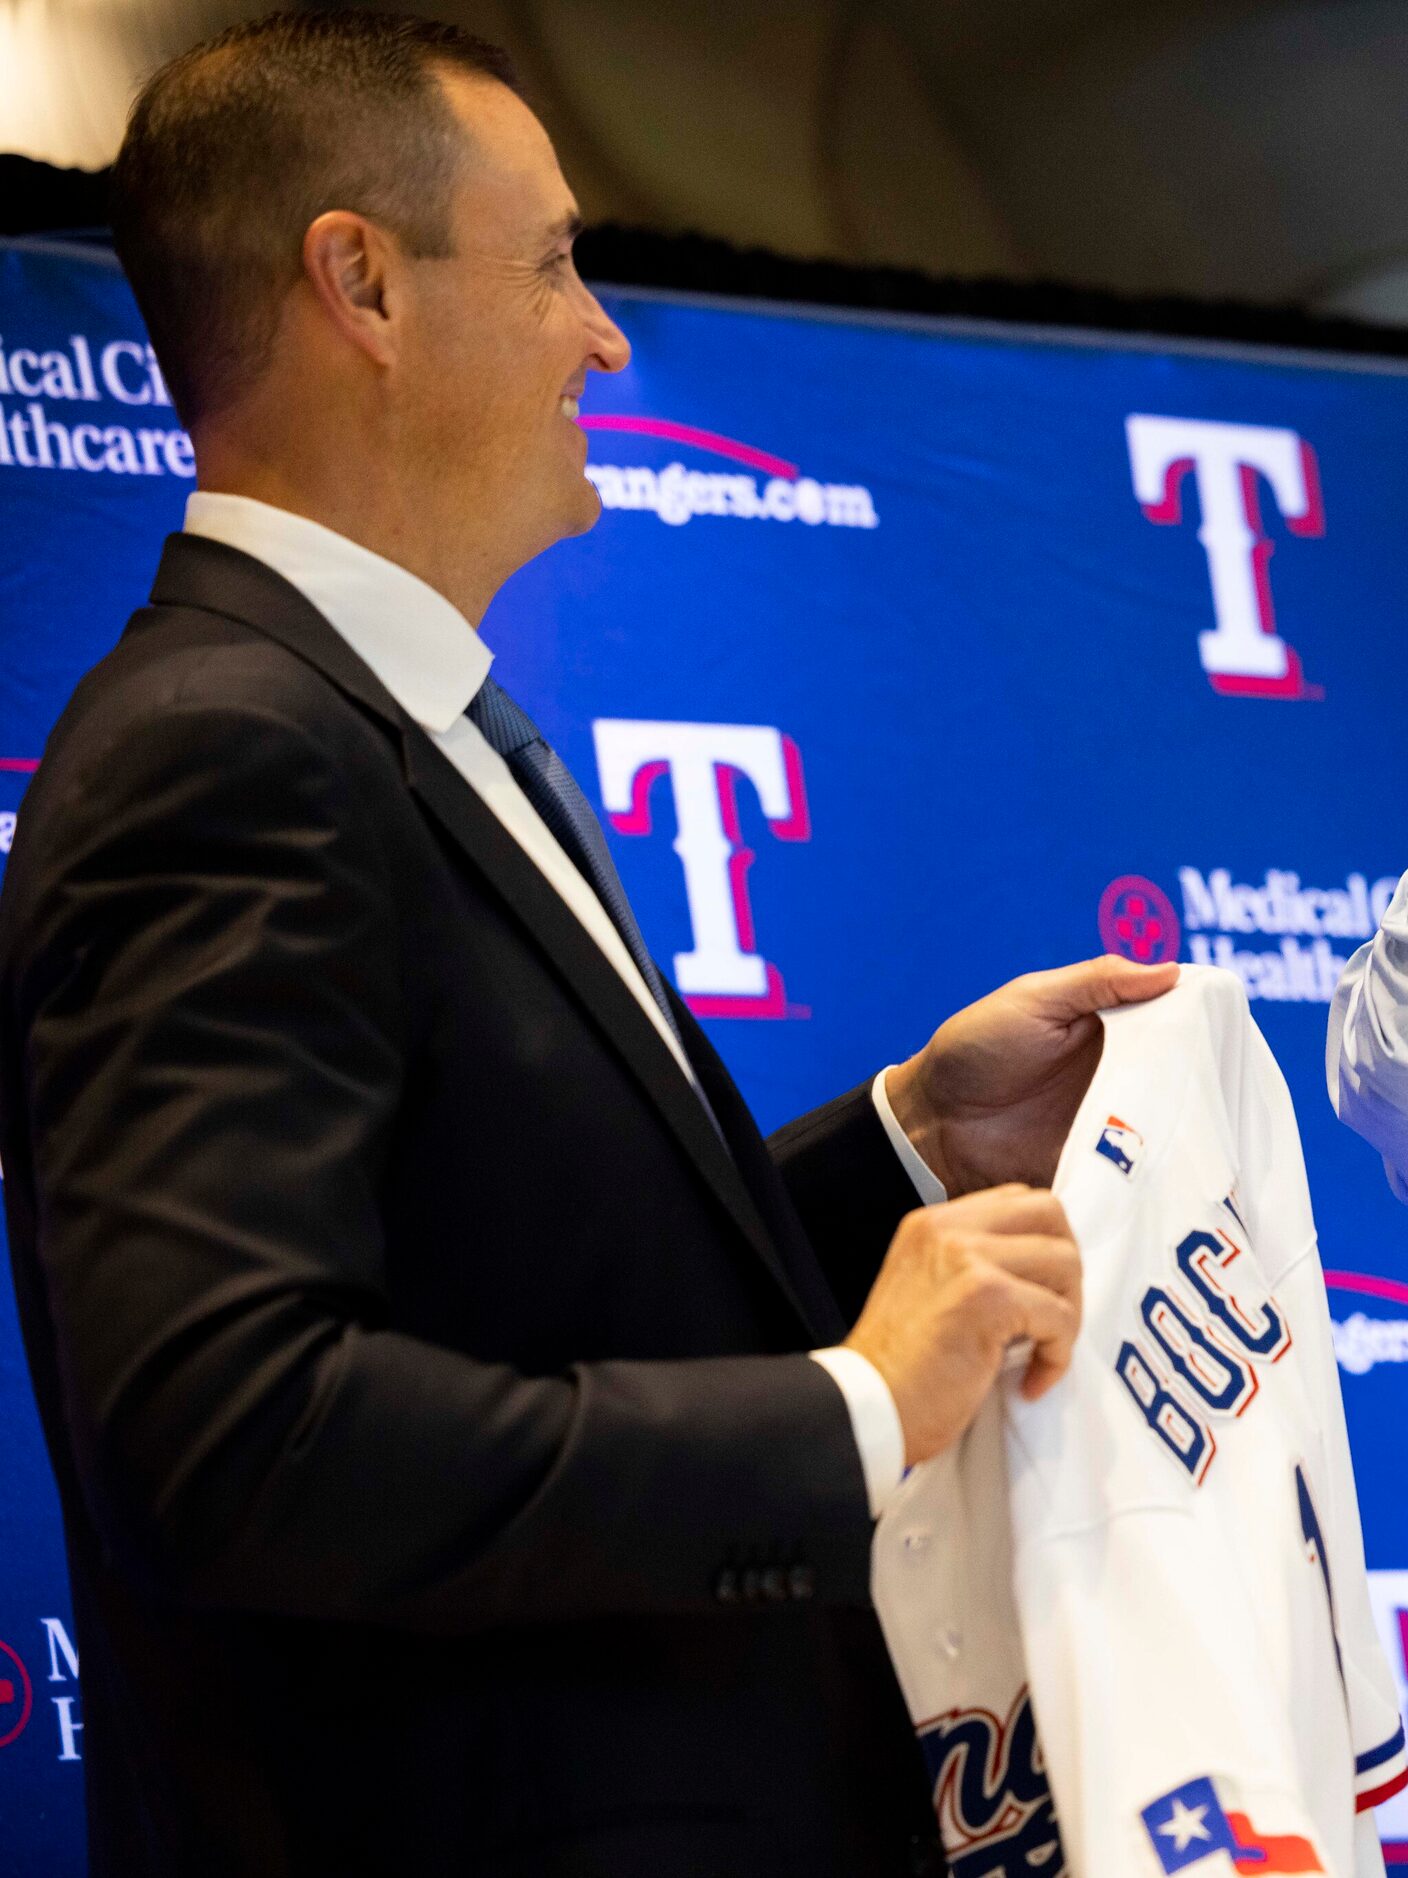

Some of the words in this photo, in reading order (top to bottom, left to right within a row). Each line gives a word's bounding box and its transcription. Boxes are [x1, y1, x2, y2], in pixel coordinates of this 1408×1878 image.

[0, 334, 101, 400] ical
[101, 340, 173, 407] Ci
[0, 402, 197, 478] lthcare
[584, 463, 880, 529] rangers.com
[1125, 413, 1326, 699] T
[592, 718, 810, 1020] T
[1188, 934, 1350, 1003] Health
[1112, 1226, 1294, 1489] BOC
